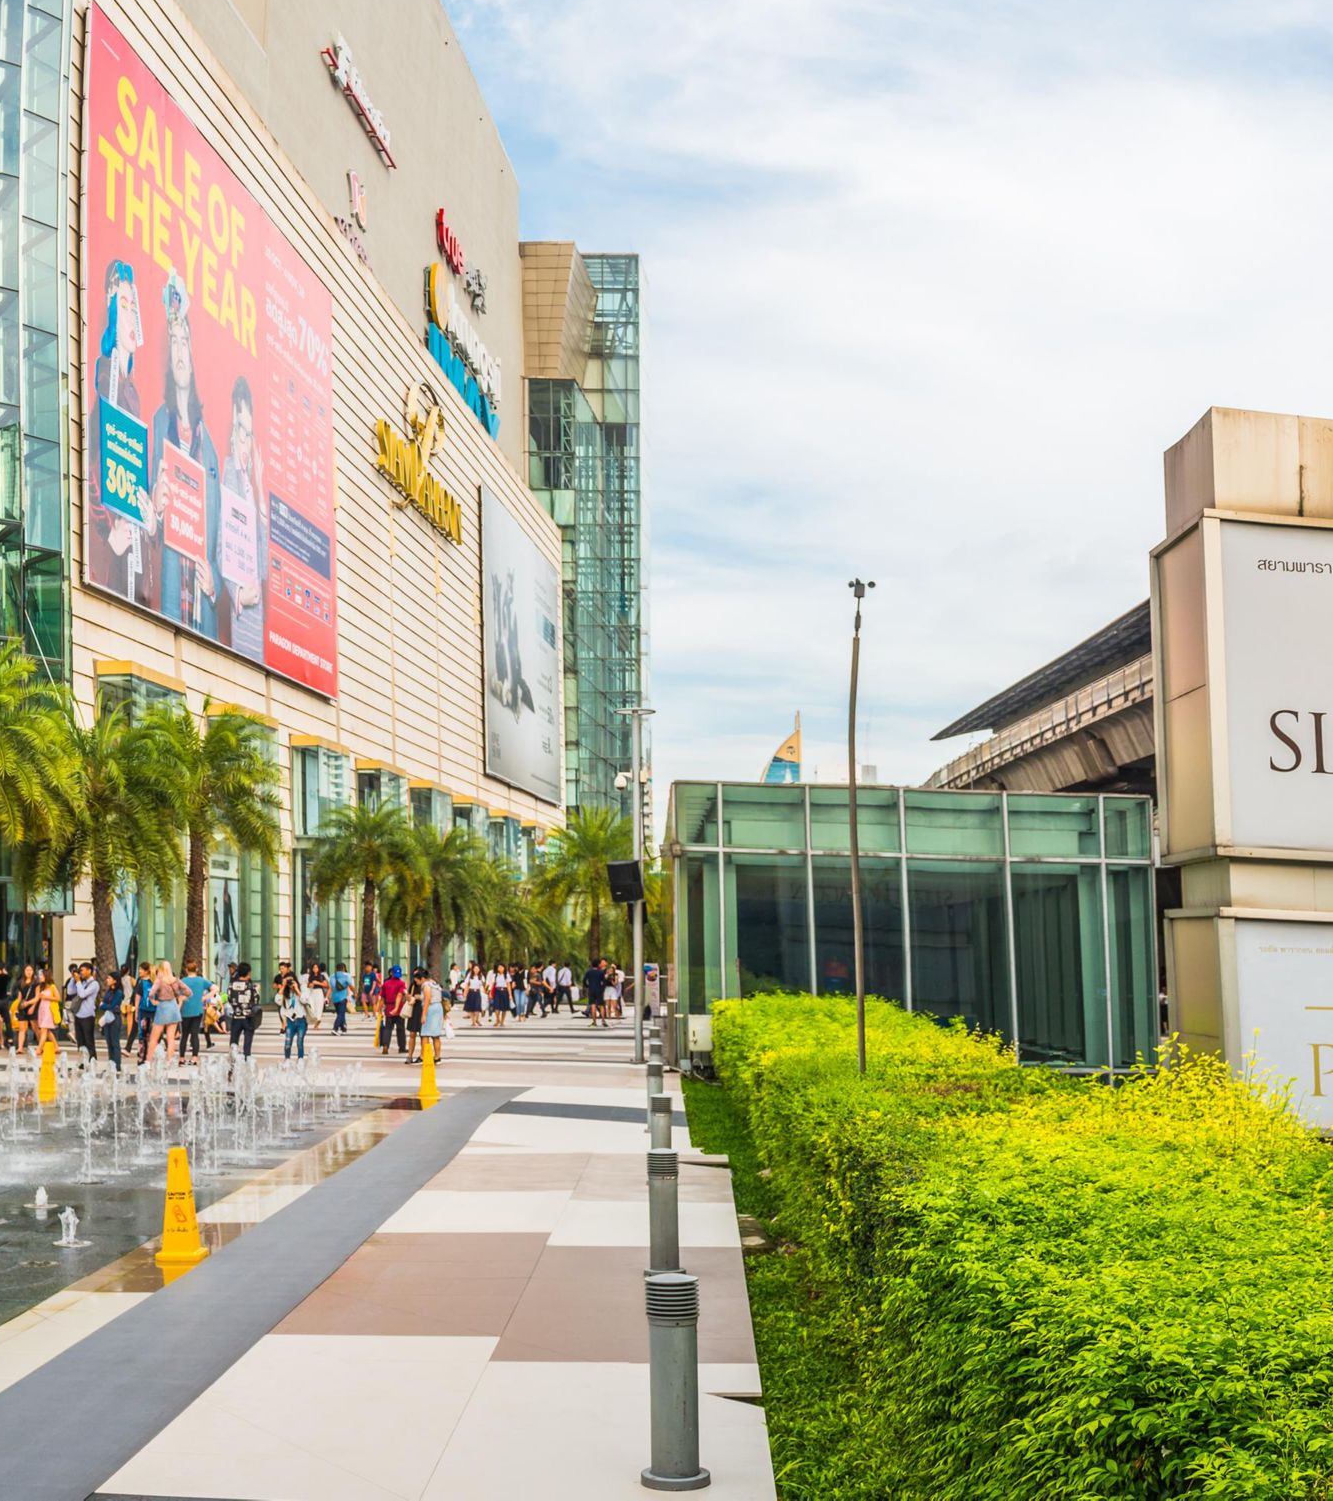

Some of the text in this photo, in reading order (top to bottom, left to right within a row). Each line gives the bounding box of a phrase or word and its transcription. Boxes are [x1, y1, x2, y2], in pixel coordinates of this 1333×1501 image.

[98, 133, 258, 359] THE YEAR
[115, 76, 245, 270] SALE OF
[1269, 709, 1333, 775] SI
